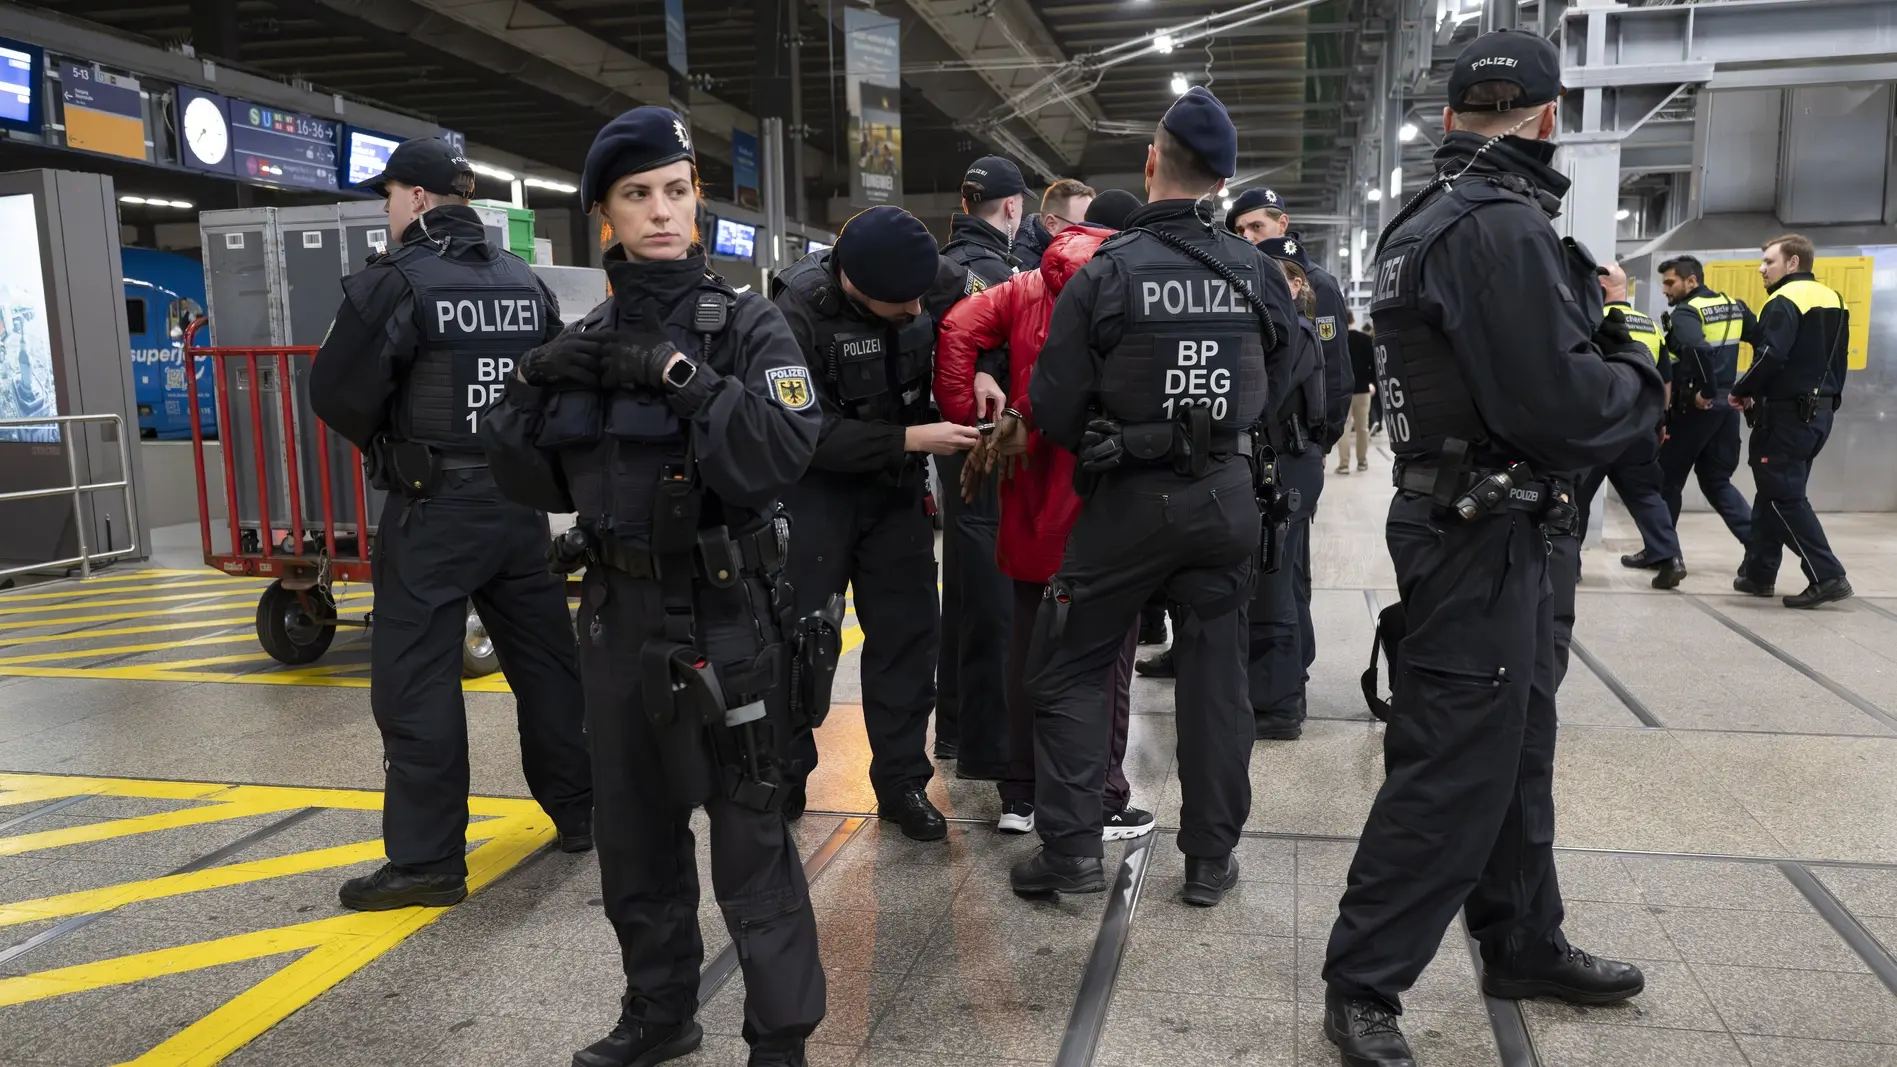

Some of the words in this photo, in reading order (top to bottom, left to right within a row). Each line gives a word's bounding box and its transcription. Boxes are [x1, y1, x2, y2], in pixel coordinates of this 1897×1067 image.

[72, 66, 89, 81] 5-13
[1471, 56, 1518, 71] POLIZEI
[249, 107, 261, 126] S
[261, 110, 272, 128] U
[296, 119, 324, 139] 16-36
[1373, 254, 1405, 303] LIZEI
[1142, 279, 1253, 316] POLIZEI
[436, 299, 539, 333] POLIZEI
[1702, 306, 1713, 316] DB
[843, 338, 881, 357] POLIZEI
[1178, 340, 1219, 366] BP
[478, 358, 514, 381] BP
[1375, 344, 1388, 376] BP
[770, 369, 806, 380] POLIZEI
[1165, 368, 1231, 394] DEG
[467, 384, 505, 408] DE
[1509, 487, 1539, 502] POLIZEI
